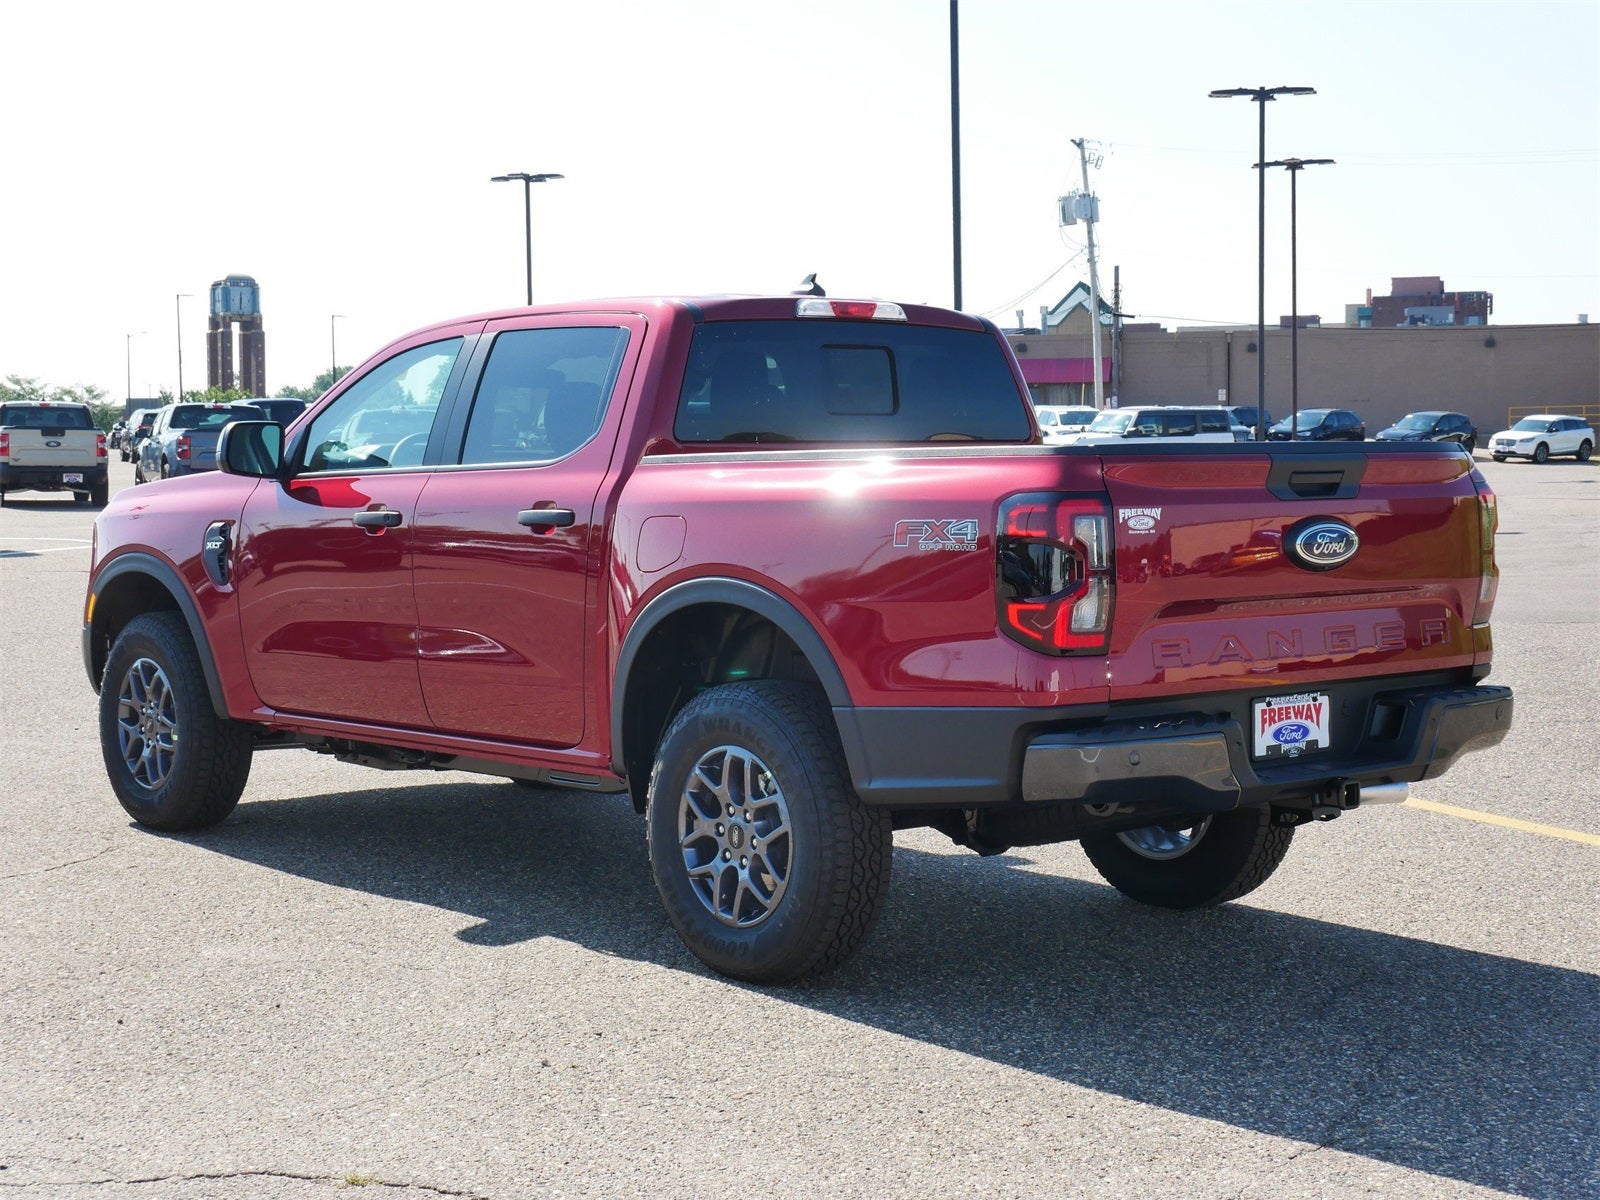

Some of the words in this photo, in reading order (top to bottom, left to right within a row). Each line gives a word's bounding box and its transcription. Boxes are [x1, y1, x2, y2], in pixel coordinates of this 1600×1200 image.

[1119, 507, 1161, 524] FREEWAY
[1133, 518, 1150, 527] Ford
[893, 519, 979, 548] FX4
[206, 542, 223, 550] XLT
[919, 543, 942, 551] OFF
[945, 543, 977, 551] ROAD
[1313, 532, 1347, 555] Ford
[1151, 618, 1450, 669] RANGER
[1261, 703, 1323, 739] FREEWAY
[1280, 725, 1304, 741] Ford
